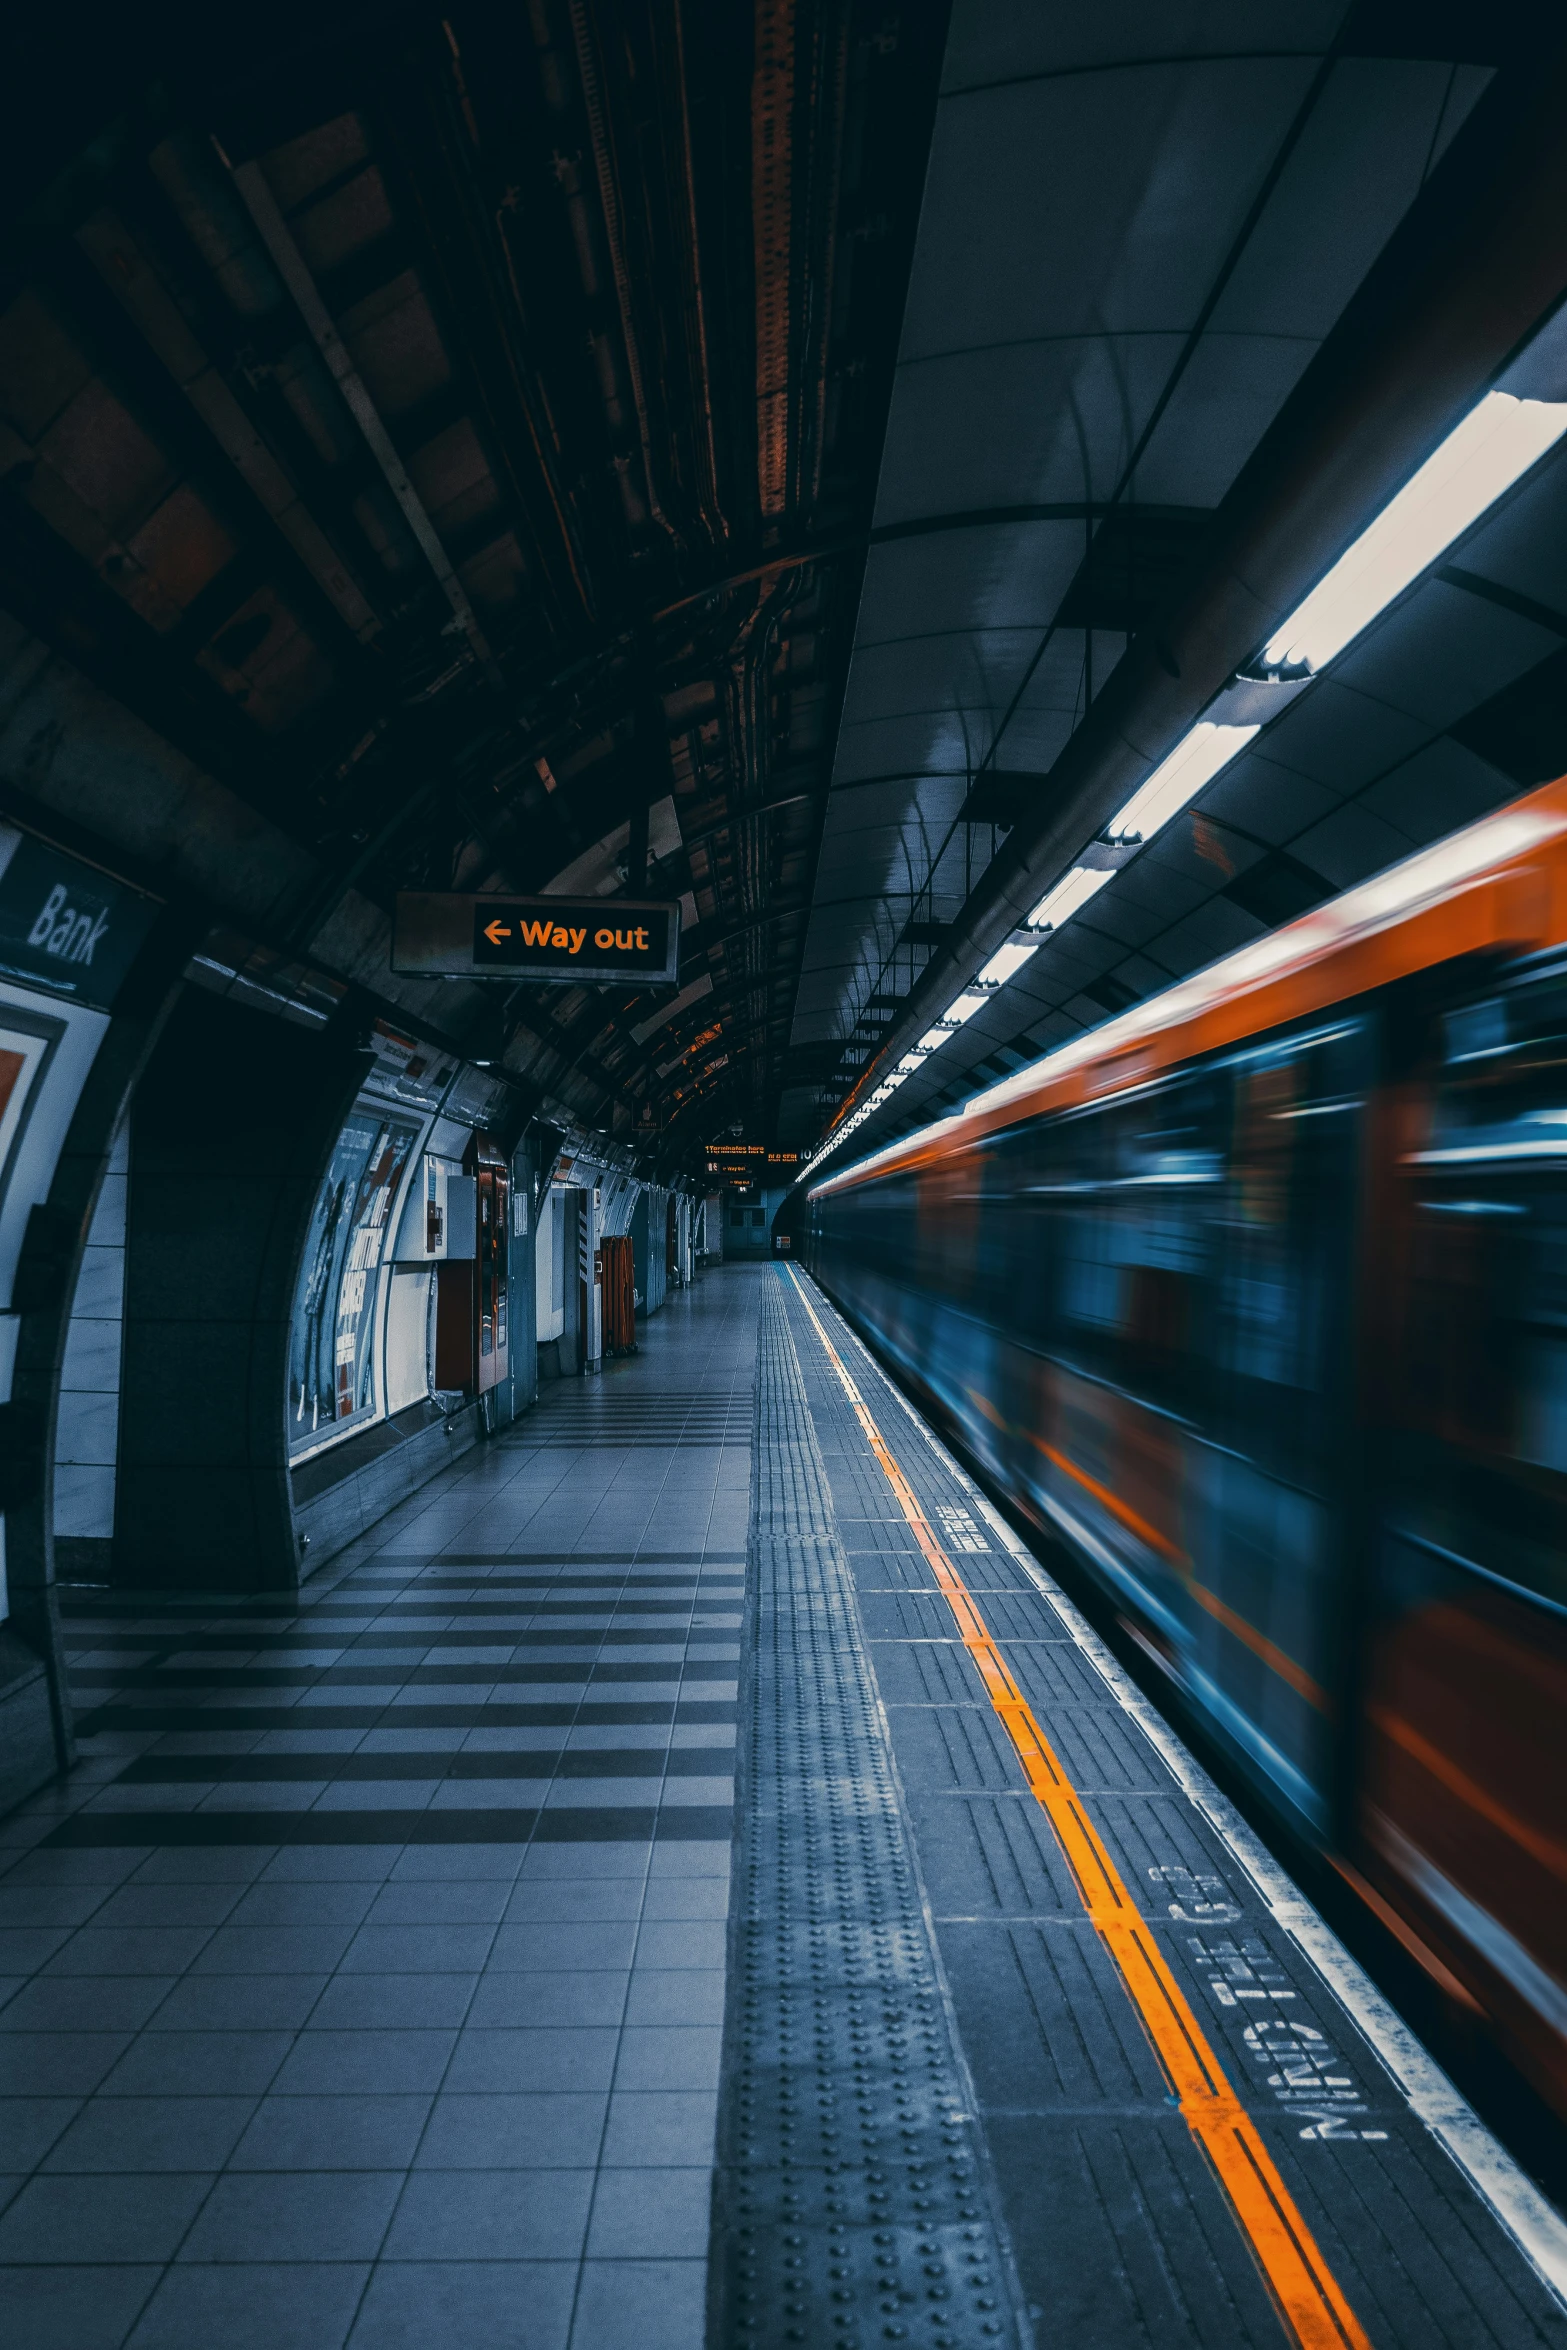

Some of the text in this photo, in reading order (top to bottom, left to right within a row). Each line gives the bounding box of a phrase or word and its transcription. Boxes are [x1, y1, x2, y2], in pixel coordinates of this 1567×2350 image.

[27, 883, 110, 966] Bank
[520, 919, 650, 954] Way out
[1187, 1937, 1297, 2007] THE
[1243, 2020, 1390, 2140] MIND
